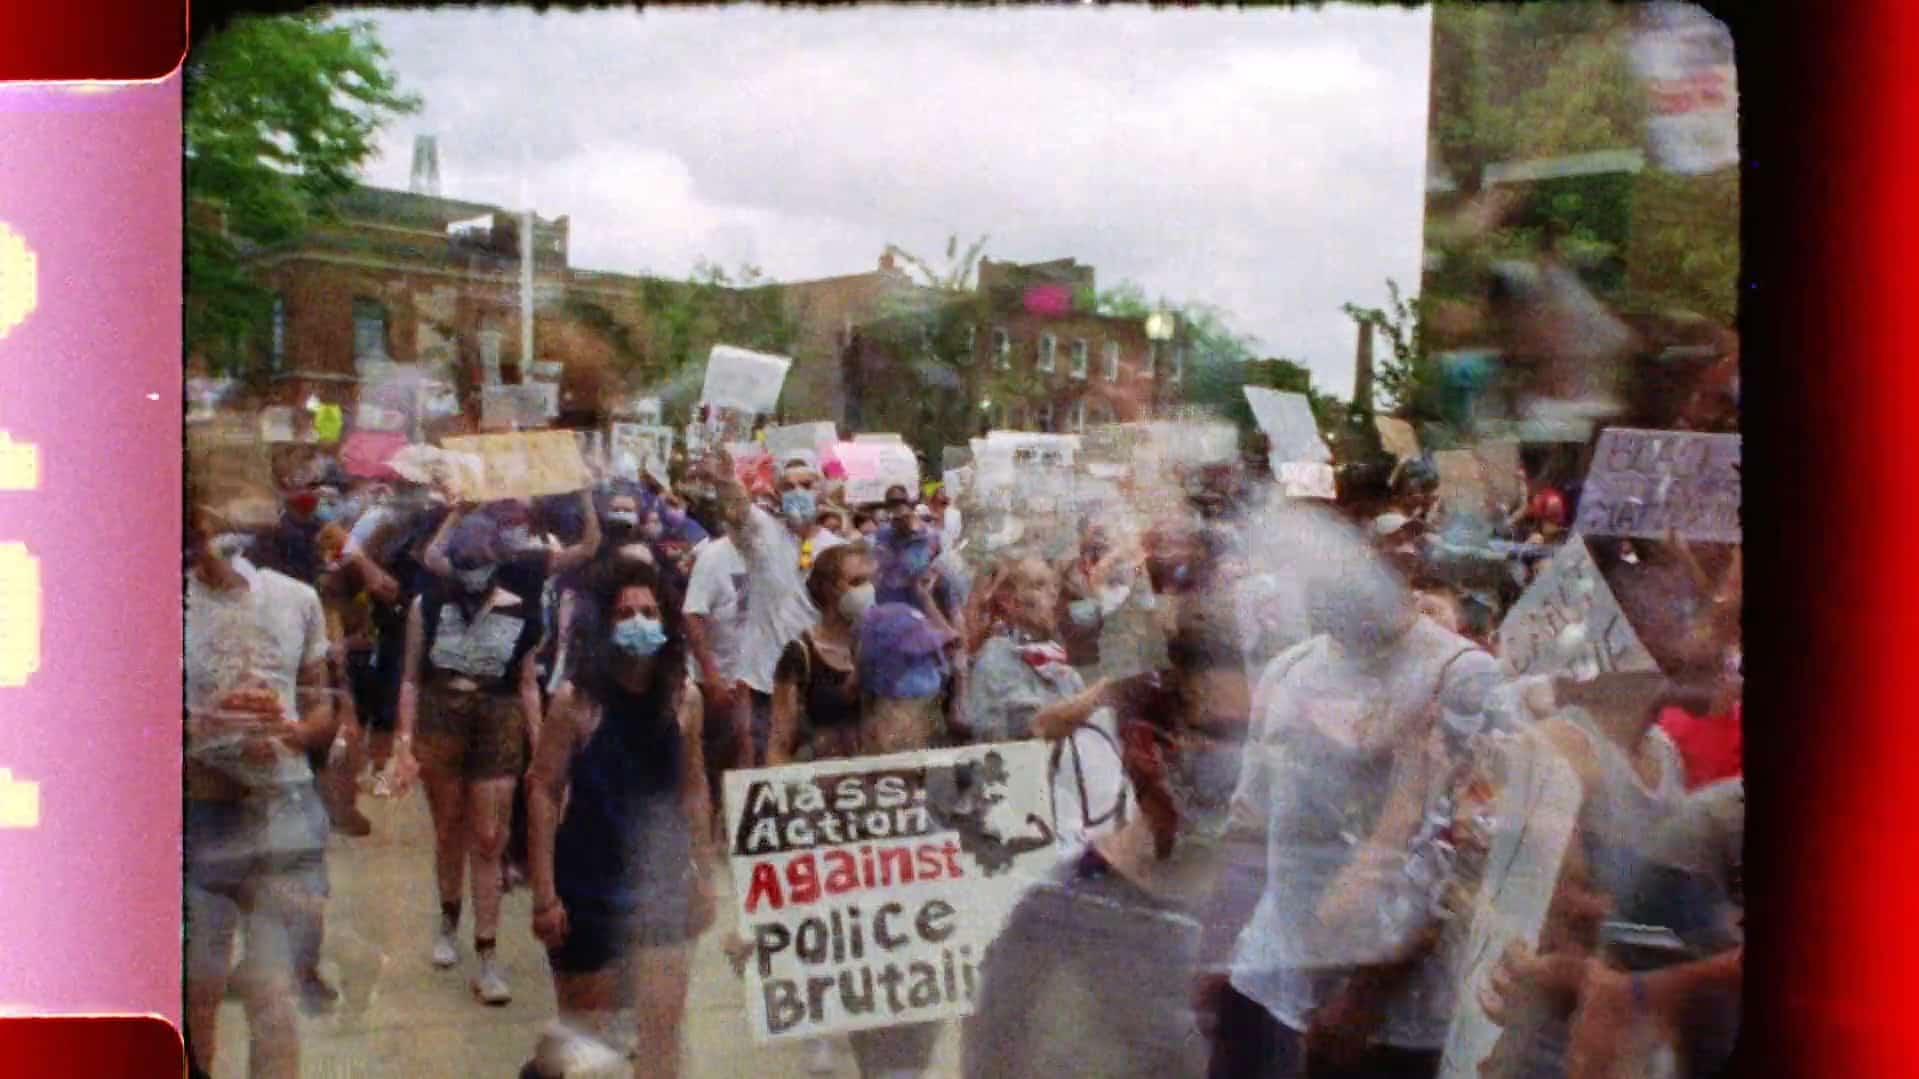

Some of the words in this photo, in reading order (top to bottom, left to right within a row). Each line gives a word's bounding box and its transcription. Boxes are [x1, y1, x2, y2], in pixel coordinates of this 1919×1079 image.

[753, 776, 927, 815] Mass.
[746, 808, 930, 852] Action
[745, 840, 964, 913] Against
[762, 945, 980, 1034] Brutali
